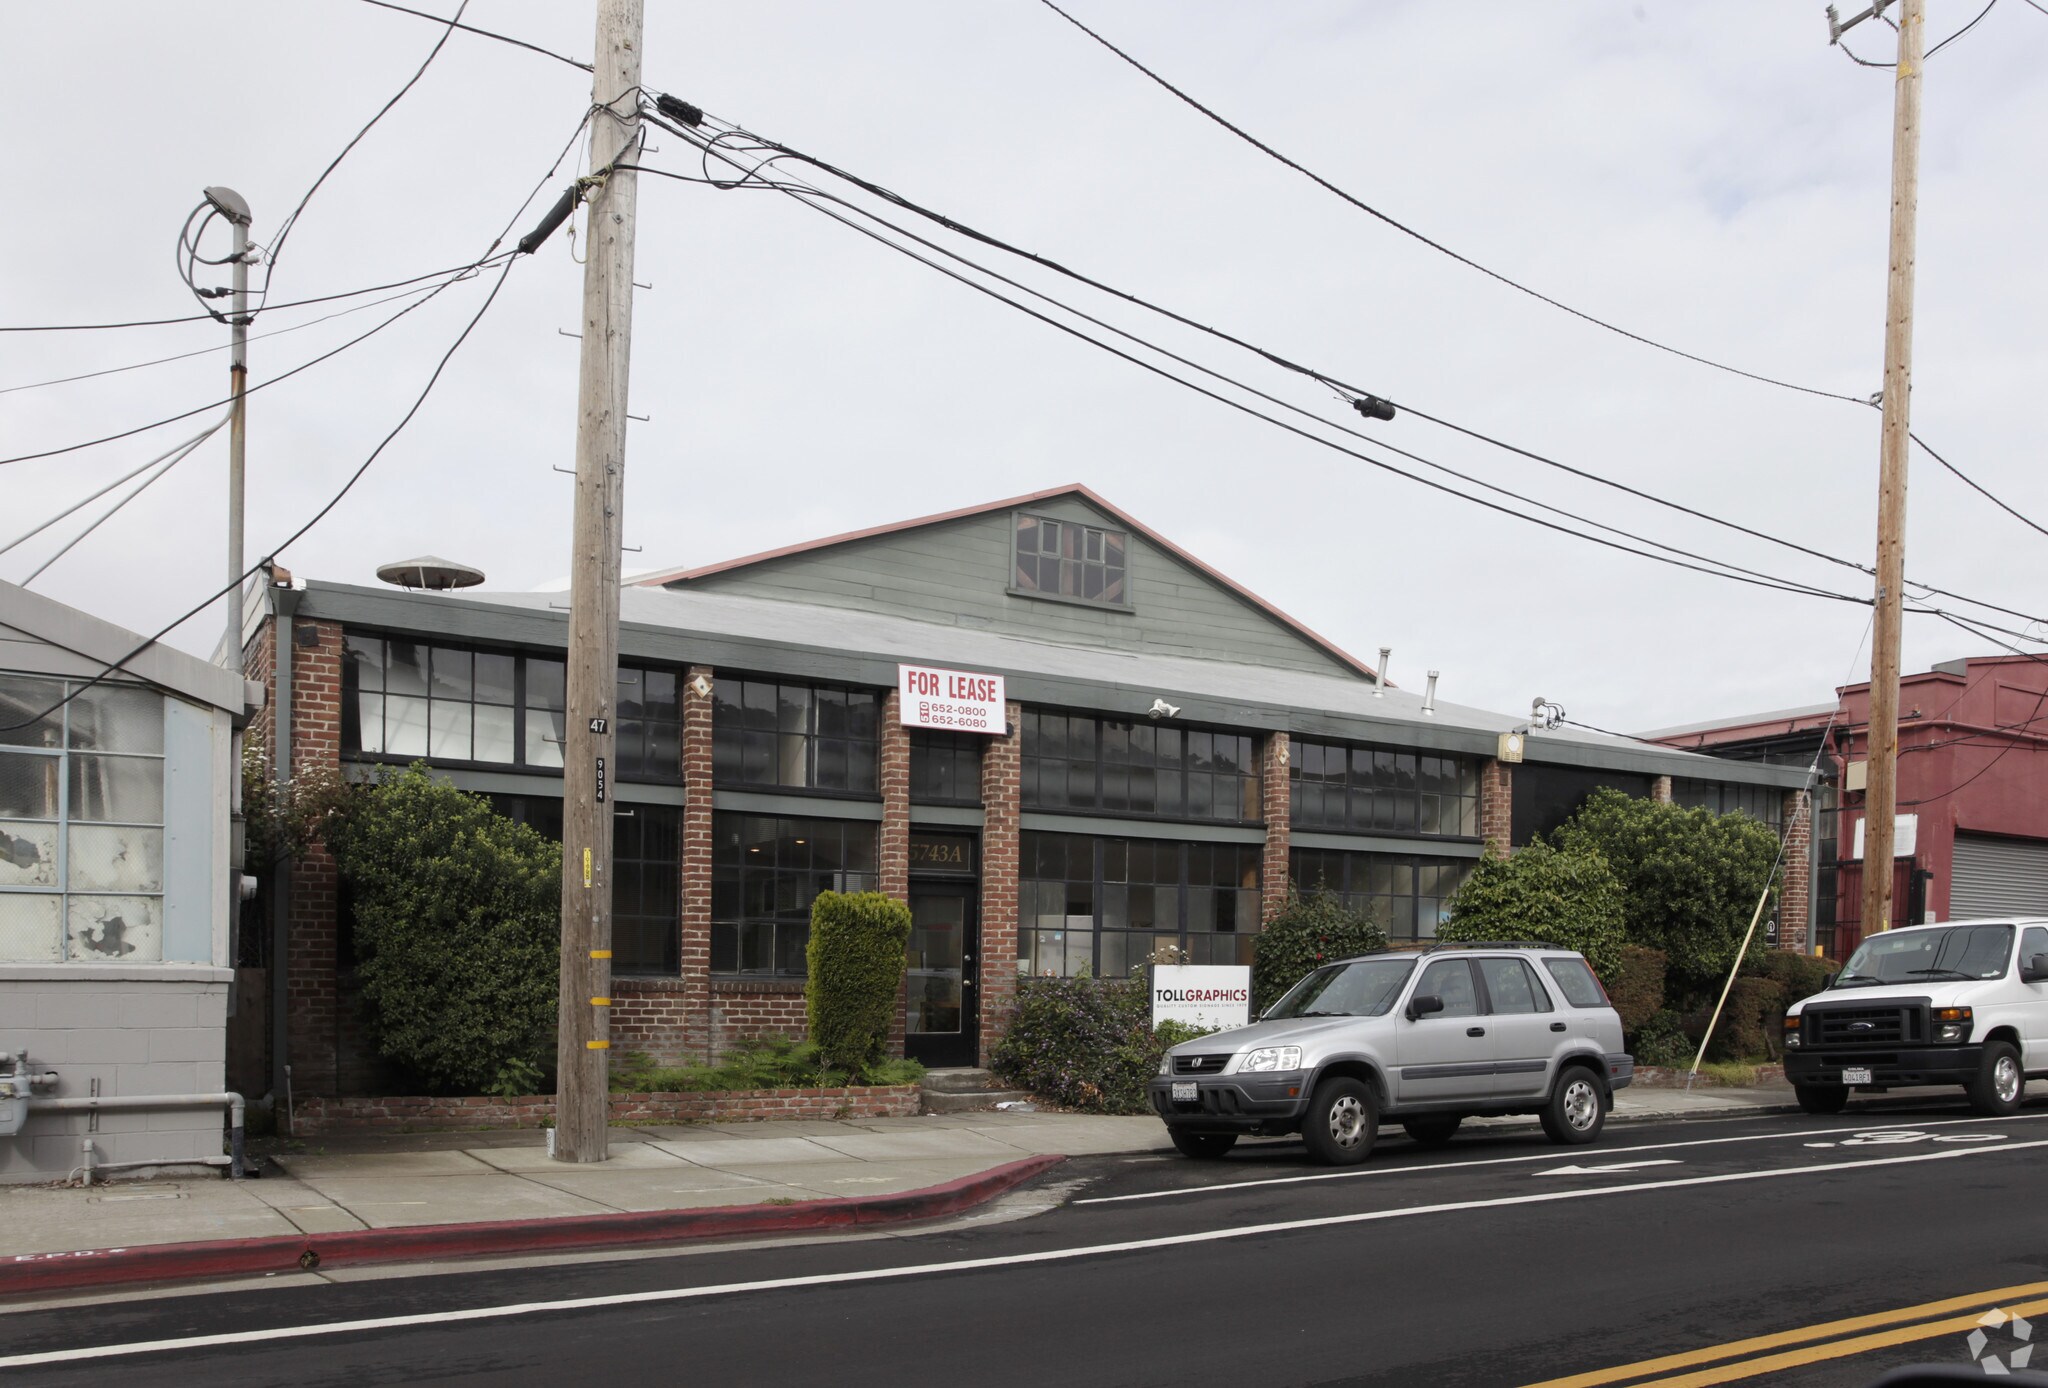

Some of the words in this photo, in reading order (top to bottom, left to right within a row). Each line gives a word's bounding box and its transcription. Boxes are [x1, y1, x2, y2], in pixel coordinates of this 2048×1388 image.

[908, 671, 940, 697] FOR
[949, 675, 997, 702] LEASE
[920, 702, 930, 723] 510
[931, 703, 987, 717] 652-0800
[590, 719, 605, 732] 47
[931, 715, 988, 728] 652-6080
[909, 843, 962, 863] 5743A
[1156, 989, 1247, 1002] TOLLGRAPHICS
